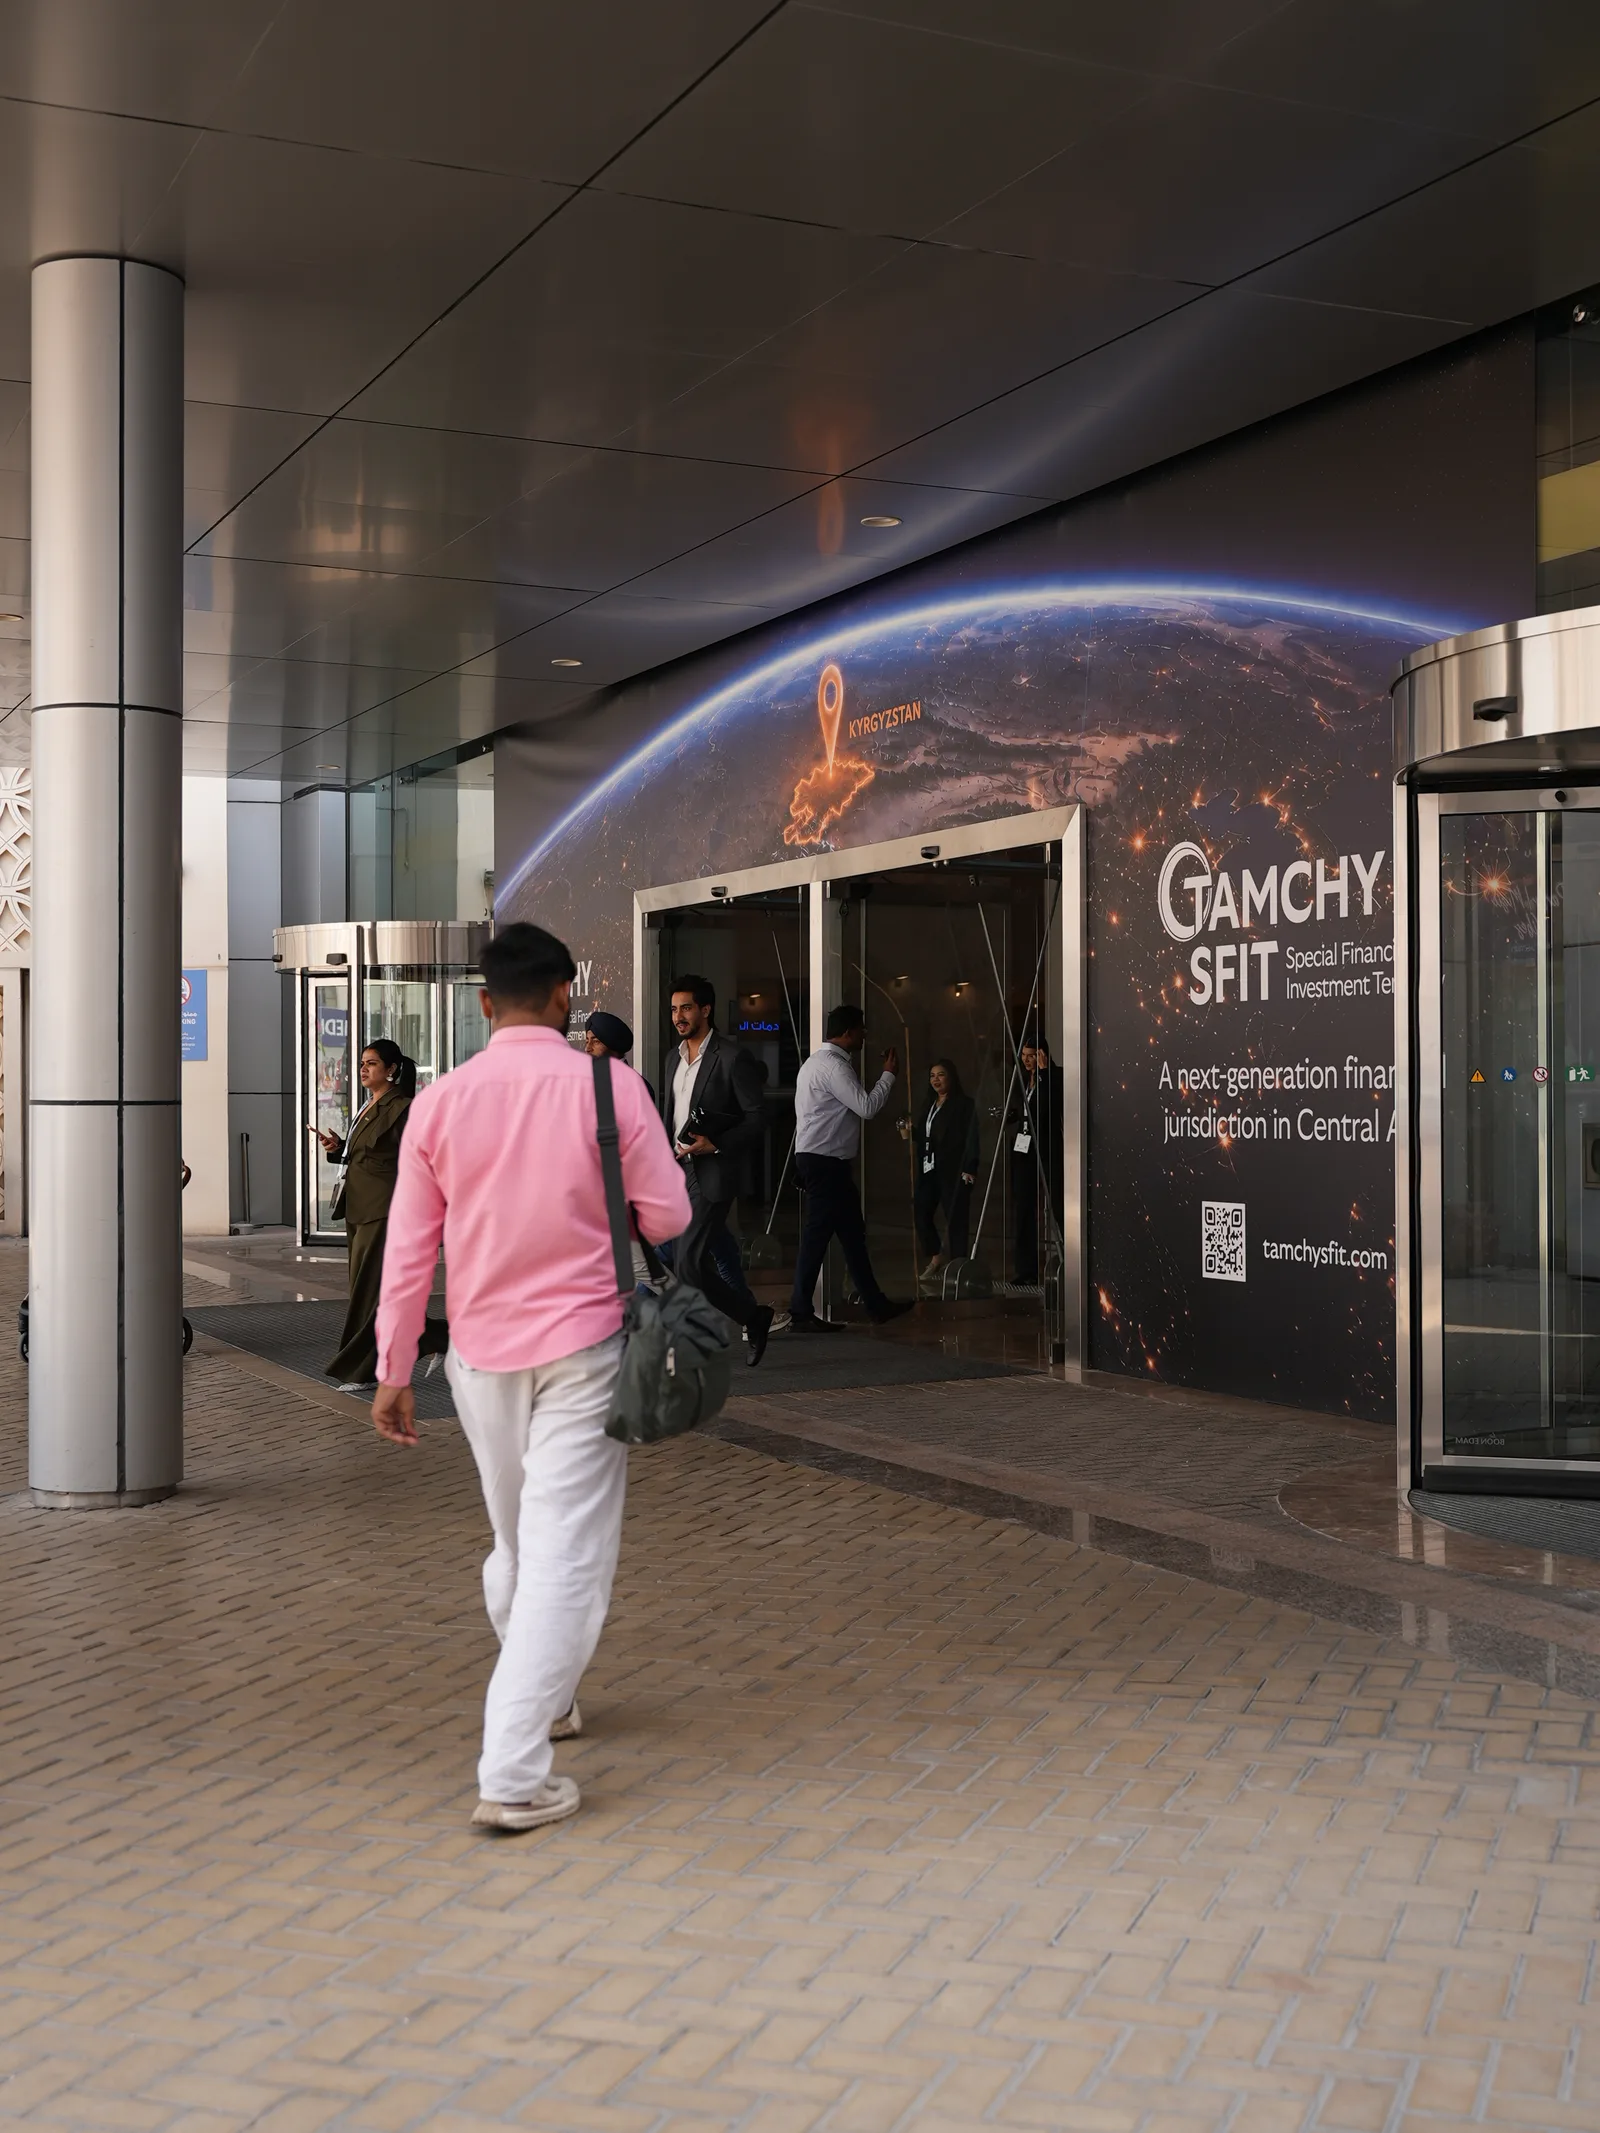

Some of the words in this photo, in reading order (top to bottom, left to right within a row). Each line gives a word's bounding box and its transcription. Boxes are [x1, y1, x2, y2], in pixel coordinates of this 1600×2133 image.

[849, 700, 922, 738] KYRGYZSTAN
[1189, 940, 1279, 1006] SFIT
[1286, 942, 1338, 973] Special
[1341, 941, 1395, 965] Financ
[1286, 976, 1371, 1000] Investment
[1158, 1061, 1173, 1090] A
[1177, 1057, 1338, 1097] next-generation
[1163, 1107, 1267, 1144] jurisdiction
[1273, 1108, 1291, 1140] in
[1297, 1108, 1379, 1142] Central
[1262, 1238, 1388, 1270] tamchysfit.com
